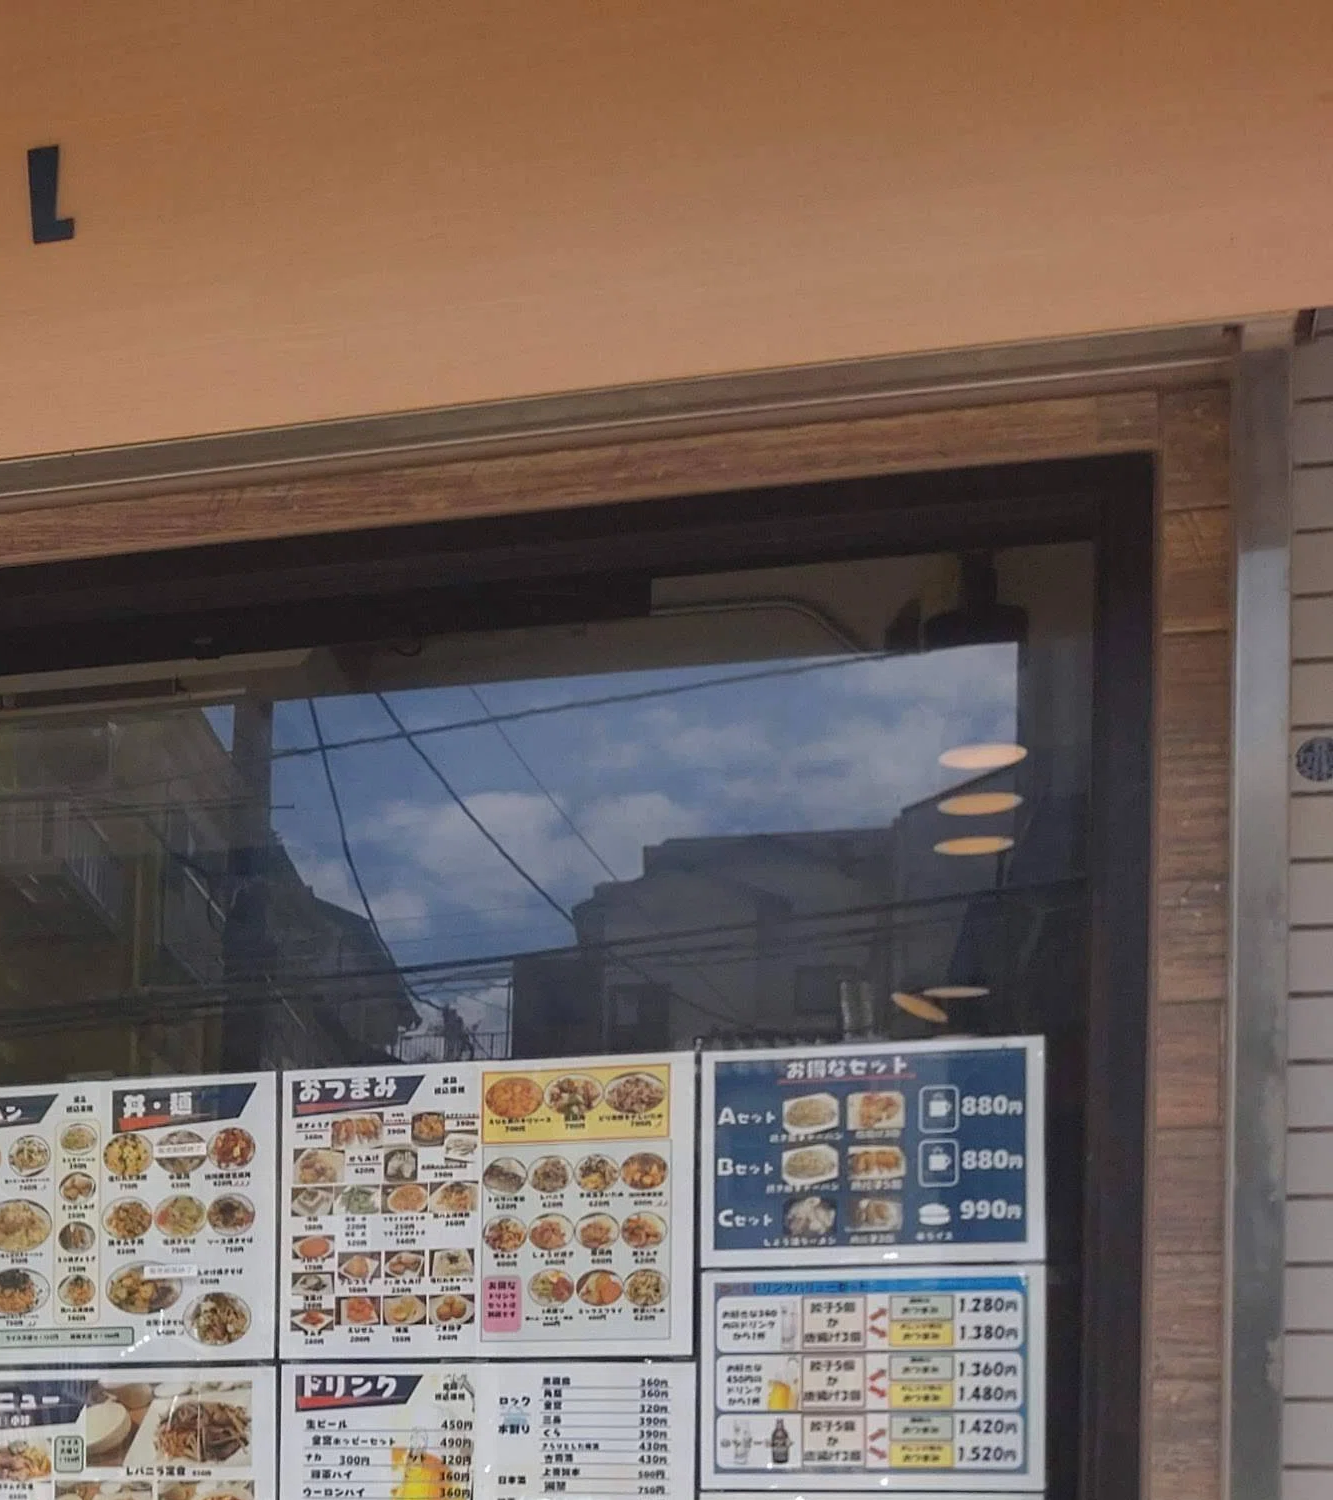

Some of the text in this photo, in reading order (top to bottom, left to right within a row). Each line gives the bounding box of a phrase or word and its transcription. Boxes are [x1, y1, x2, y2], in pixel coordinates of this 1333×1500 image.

[786, 1055, 908, 1080] お得なセット
[299, 1077, 397, 1103] おつまみ
[717, 1095, 1024, 1126] Aセット 880円
[717, 1149, 1023, 1176] Bセット 880円
[717, 1199, 1023, 1228] Cセット 990円
[811, 1301, 856, 1314] 餃子5個
[810, 1360, 855, 1372] 餃子5個
[303, 1374, 398, 1398] ドリンク
[499, 1396, 531, 1406] ロック
[639, 1403, 668, 1414] 320円
[305, 1419, 473, 1431] 生ビール 450円
[497, 1424, 531, 1435] 水割り
[810, 1421, 856, 1433] 餃子5個
[439, 1437, 472, 1449] 490円
[339, 1455, 370, 1466] 300円
[439, 1471, 471, 1482] 360円
[497, 1475, 527, 1485] 日本酒
[303, 1488, 471, 1498] ウーロンハイ 360円
